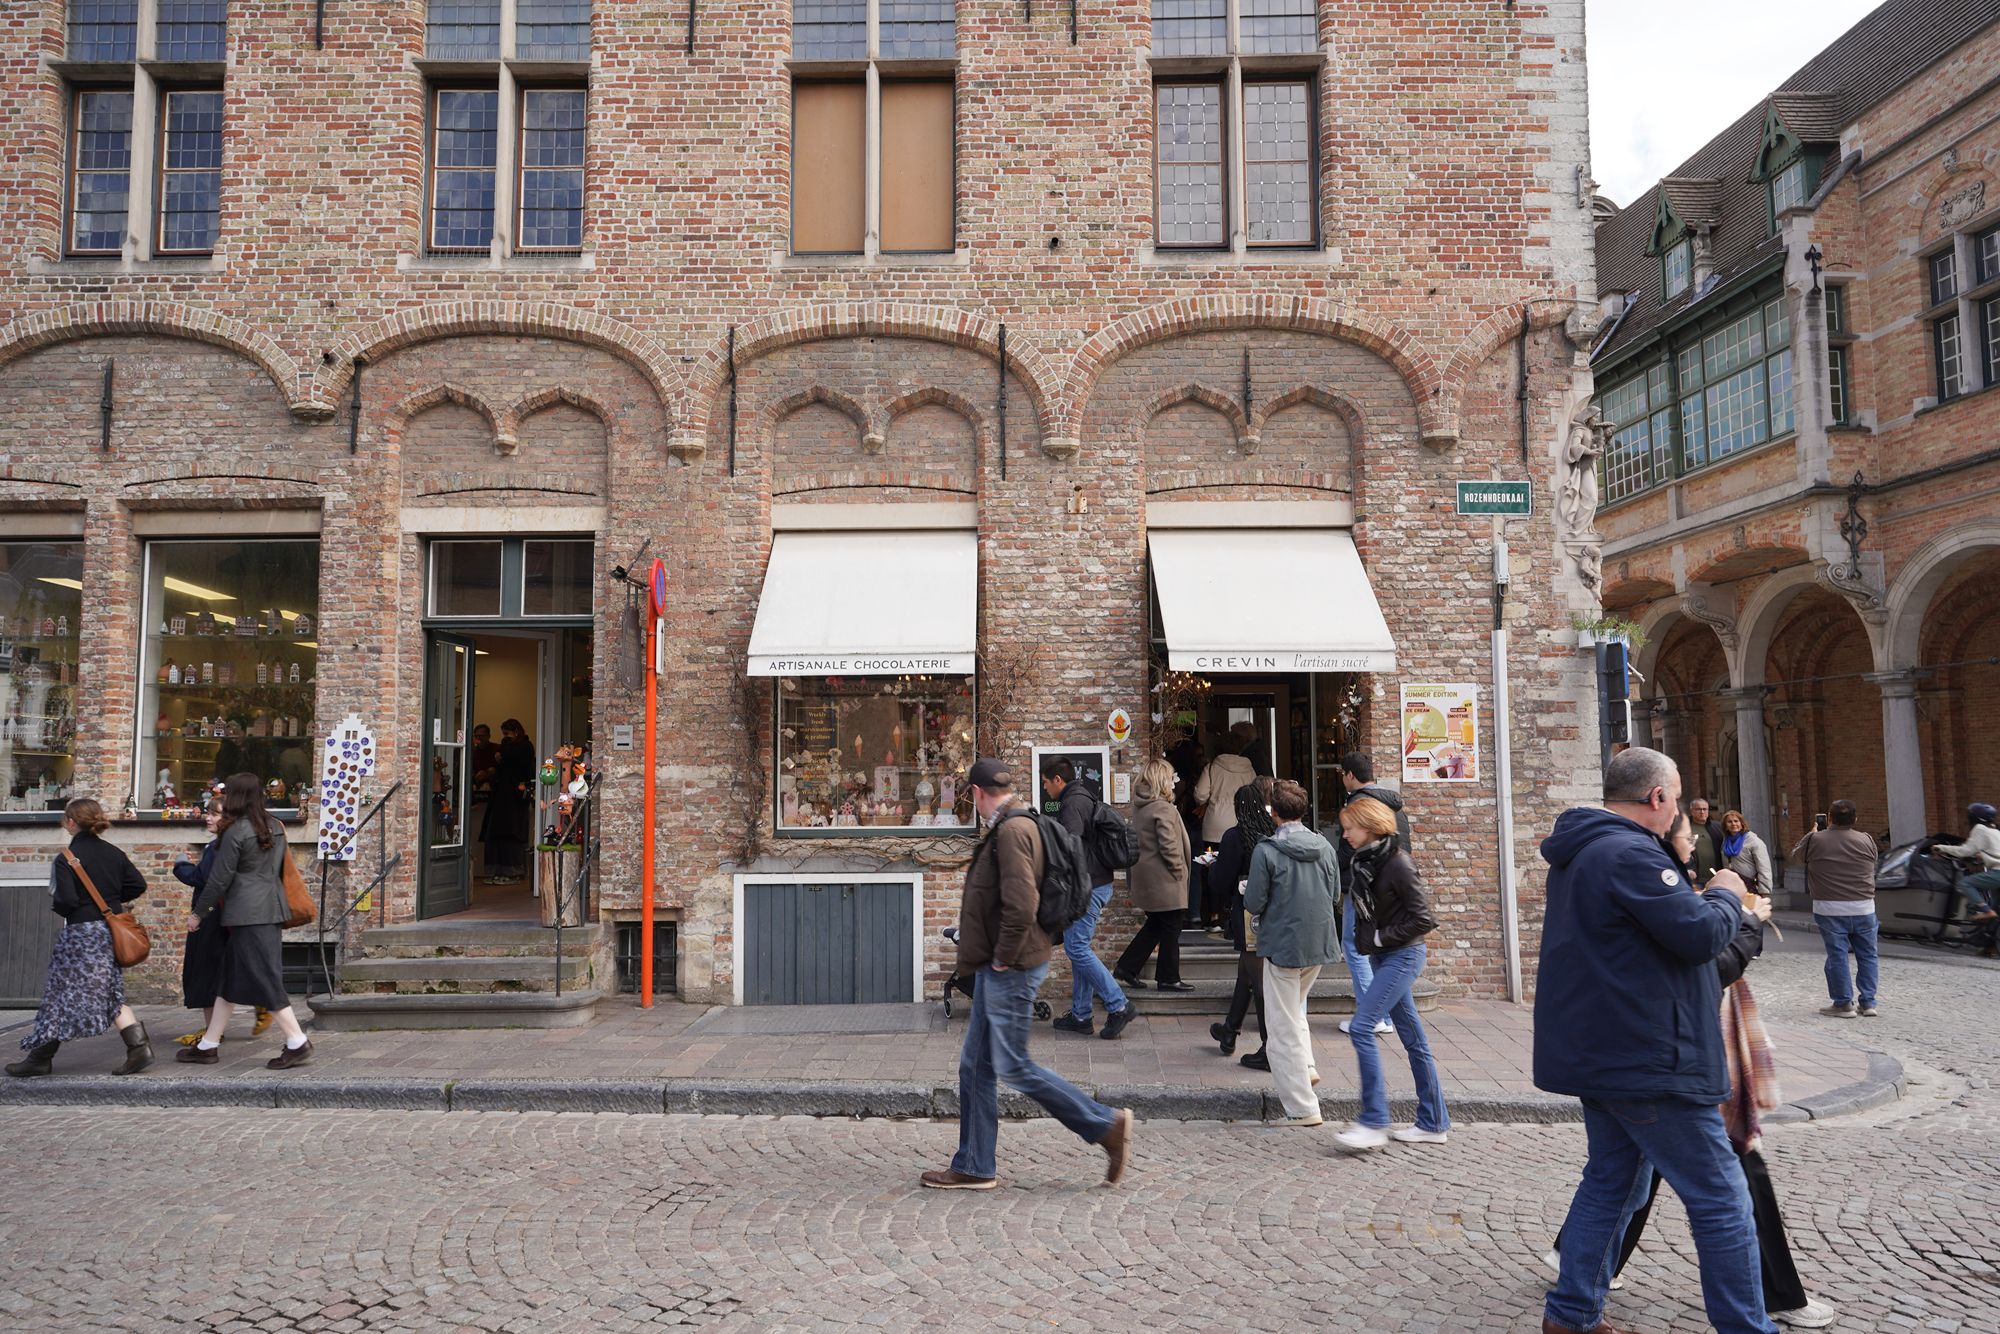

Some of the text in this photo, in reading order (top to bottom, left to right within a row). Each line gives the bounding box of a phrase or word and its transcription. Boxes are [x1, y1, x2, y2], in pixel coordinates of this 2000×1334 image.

[769, 659, 951, 671] ARTISANALE CHOCOLATERIE
[1196, 654, 1369, 668] CREVIN l'artisan sucré
